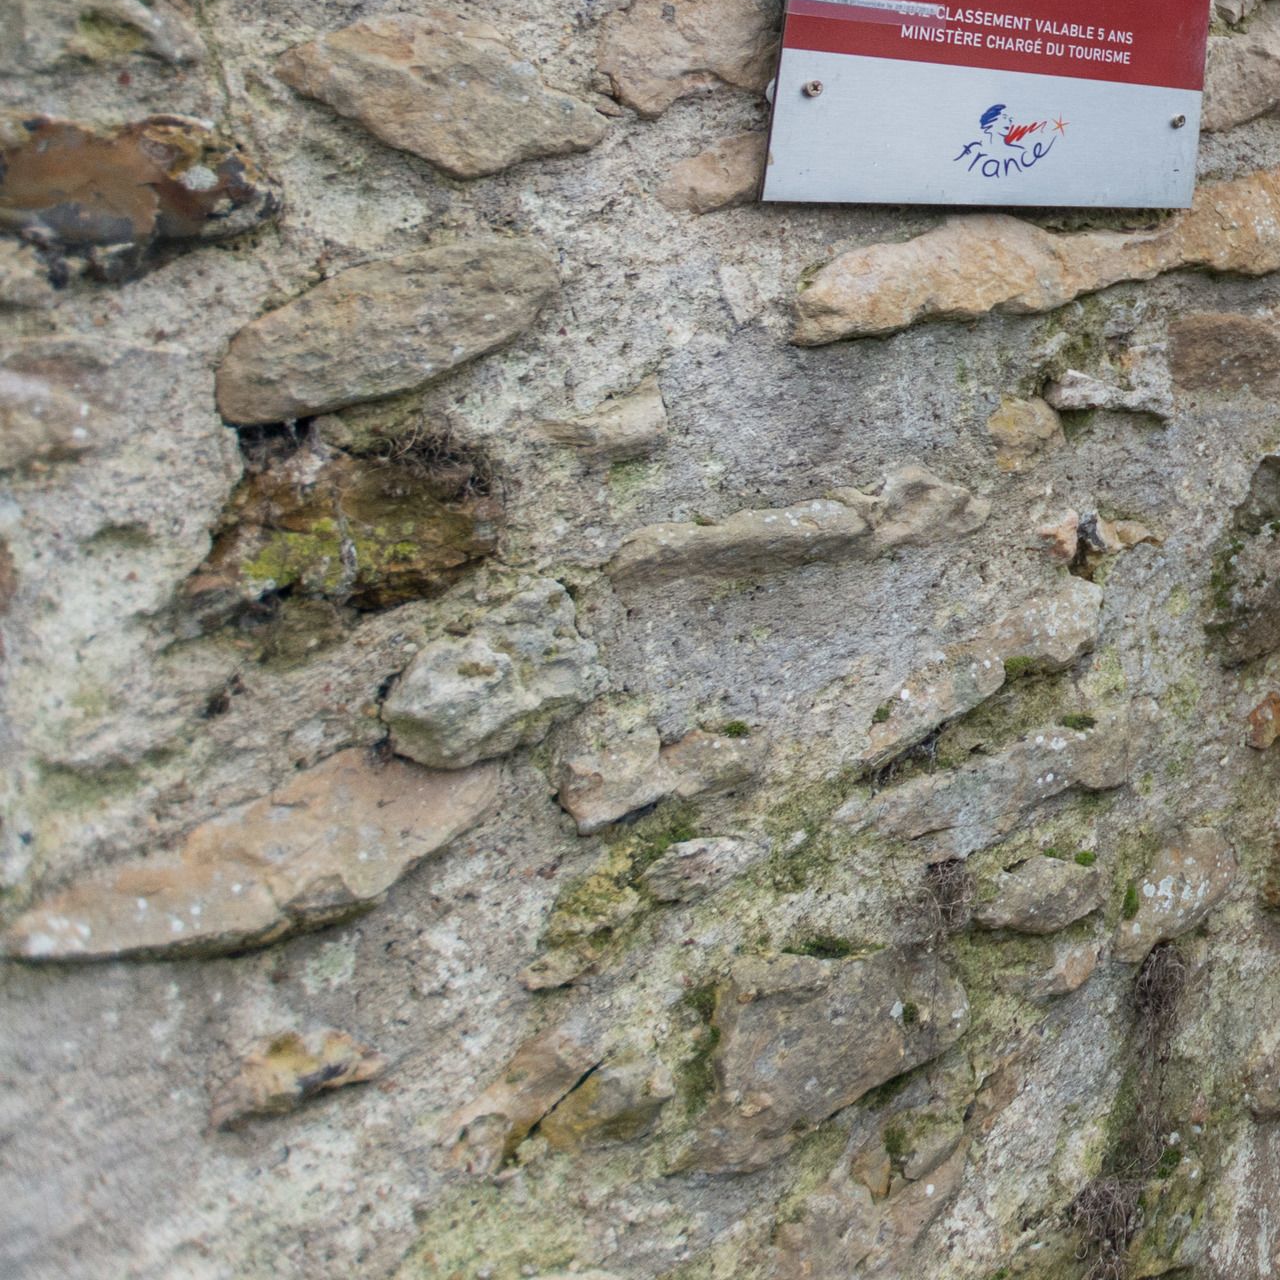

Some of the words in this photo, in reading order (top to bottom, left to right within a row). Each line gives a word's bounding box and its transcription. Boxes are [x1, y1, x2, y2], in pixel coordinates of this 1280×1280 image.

[901, 24, 983, 48] MINISTÈRE
[986, 35, 1043, 54] CHARGÉ
[1046, 42, 1065, 57] DU
[1068, 44, 1132, 65] TOURISME
[936, 6, 1032, 31] CLASSEMENT
[1035, 19, 1095, 40] VALABLE
[1097, 29, 1105, 41] 5
[1107, 31, 1134, 44] ANS
